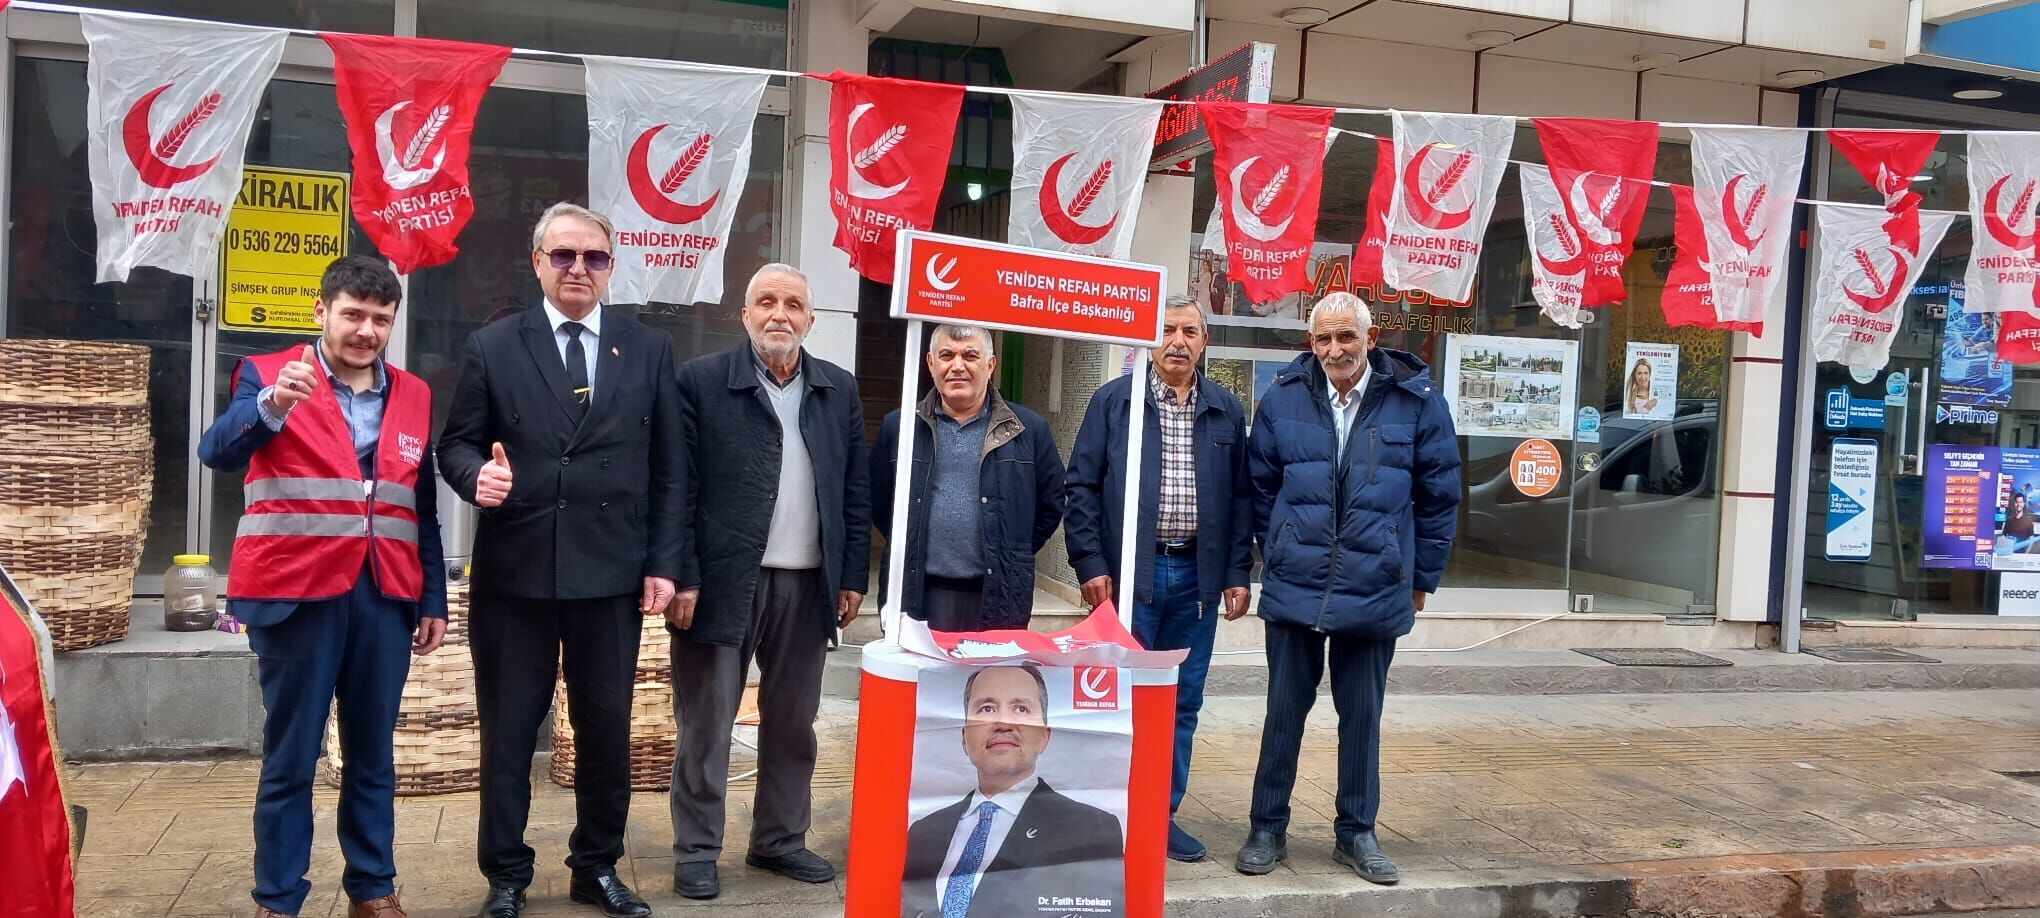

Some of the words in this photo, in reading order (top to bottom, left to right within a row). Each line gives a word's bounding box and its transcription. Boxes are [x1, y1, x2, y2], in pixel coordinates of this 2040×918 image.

[234, 174, 340, 212] KİRALIK
[430, 184, 470, 207] REFA
[168, 197, 222, 218] REFAH
[398, 205, 455, 233] PRTİSİ
[230, 229, 239, 250] 0
[243, 229, 270, 253] 536
[274, 232, 300, 254] 229
[304, 234, 339, 256] 5564
[683, 233, 719, 251] REFA
[1390, 233, 1445, 251] ENİDEN
[645, 251, 700, 269] PARTİSİ
[1408, 251, 1462, 269] PARTİSİ
[1246, 265, 1283, 280] ARTİSİ
[231, 282, 268, 295] ŞİMŞEK
[271, 286, 297, 296] GRUP
[300, 285, 322, 298] İNŞA
[996, 270, 1055, 290] YENİDEN
[1058, 278, 1100, 296] REFAH
[1103, 284, 1151, 303] PARTİSİ
[918, 291, 944, 299] YENİDEN
[945, 294, 966, 302] REFAH
[929, 300, 953, 308] PARTİSİ
[1010, 293, 1044, 311] Bafra
[1047, 295, 1070, 315] İlçe
[1072, 301, 1135, 323] Başkanlığı
[1949, 408, 1998, 424] prime
[1536, 465, 1556, 476] 400
[1038, 896, 1050, 905] Dr.
[1052, 896, 1074, 906] Fatih
[1075, 897, 1111, 906] Erbakan
